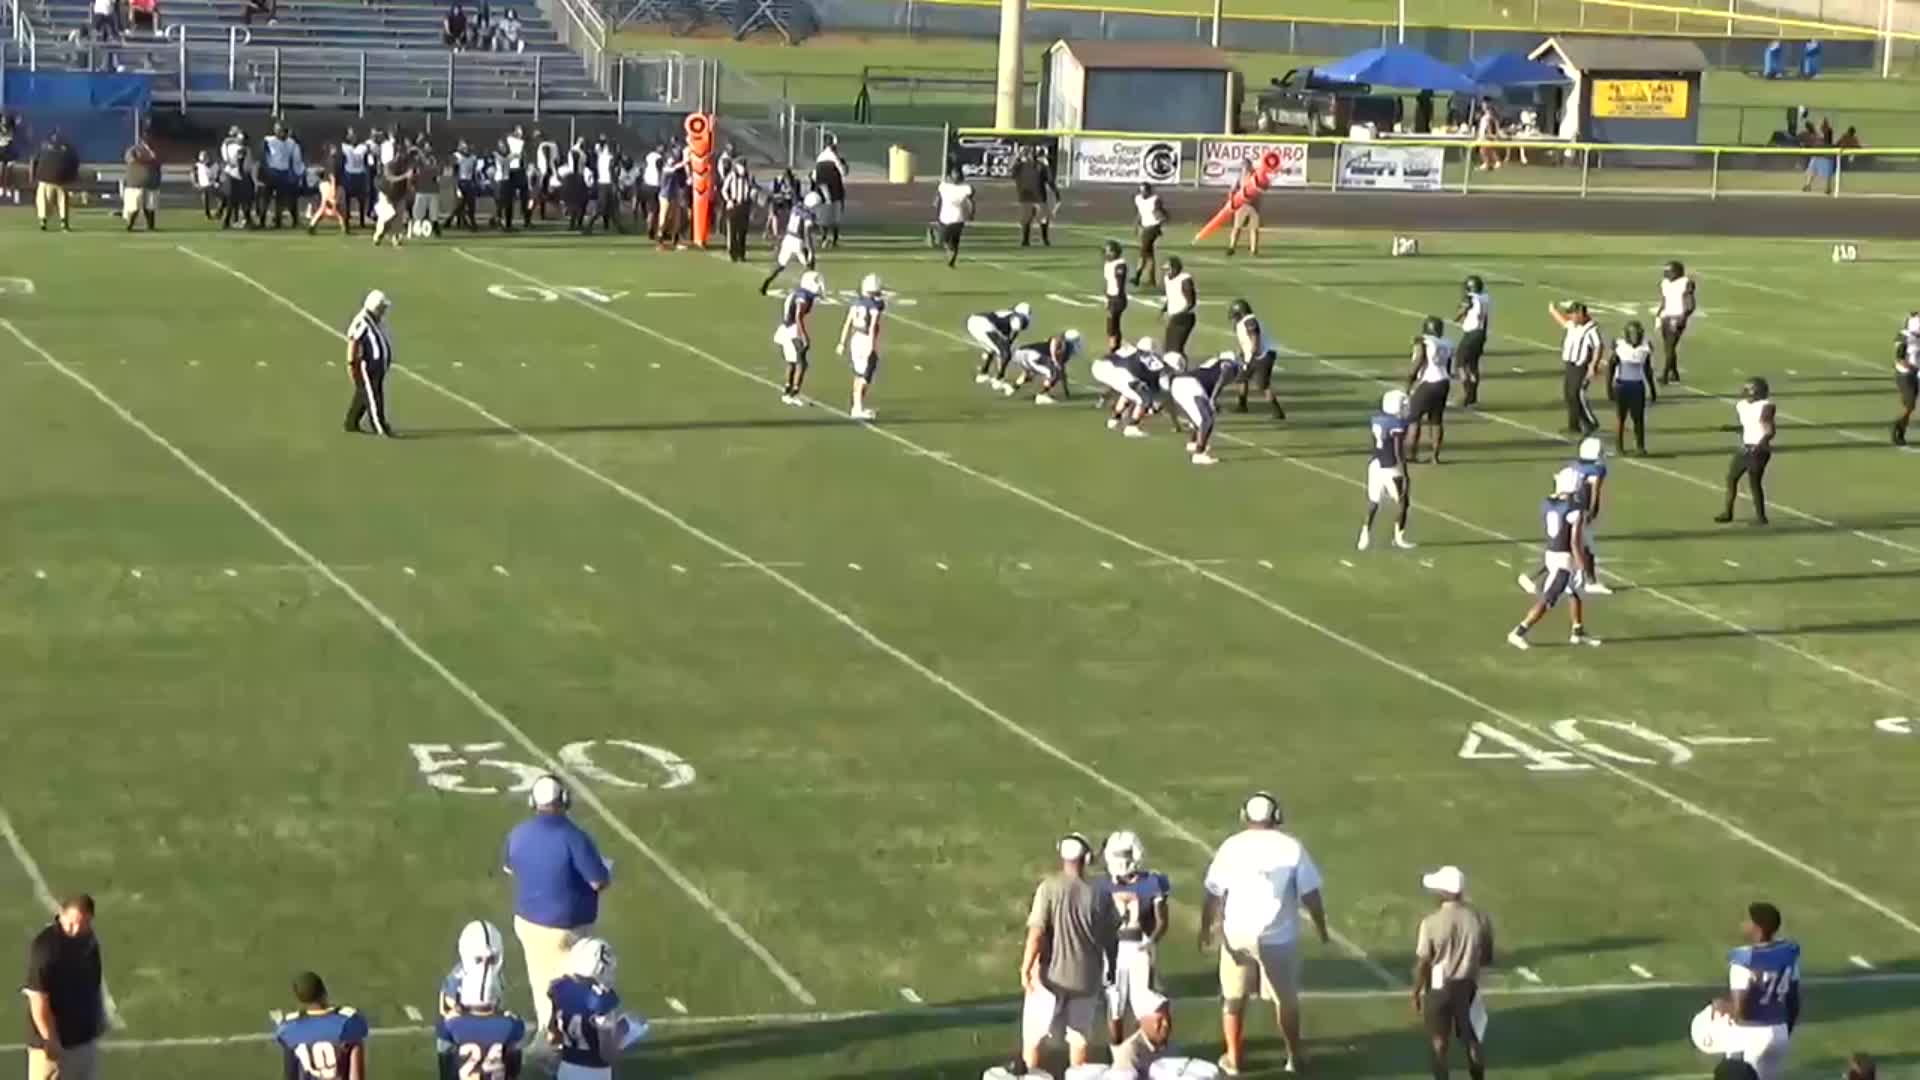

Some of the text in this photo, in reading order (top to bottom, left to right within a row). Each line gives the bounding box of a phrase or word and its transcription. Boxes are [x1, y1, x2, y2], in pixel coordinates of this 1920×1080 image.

[1075, 152, 1141, 167] Production
[1112, 143, 1142, 156] Crop
[1088, 163, 1140, 177] Services
[1459, 718, 1694, 771] 40
[408, 740, 697, 794] 50
[1759, 964, 1792, 1005] 74
[295, 1041, 337, 1079] 10
[458, 1042, 506, 1080] 24
